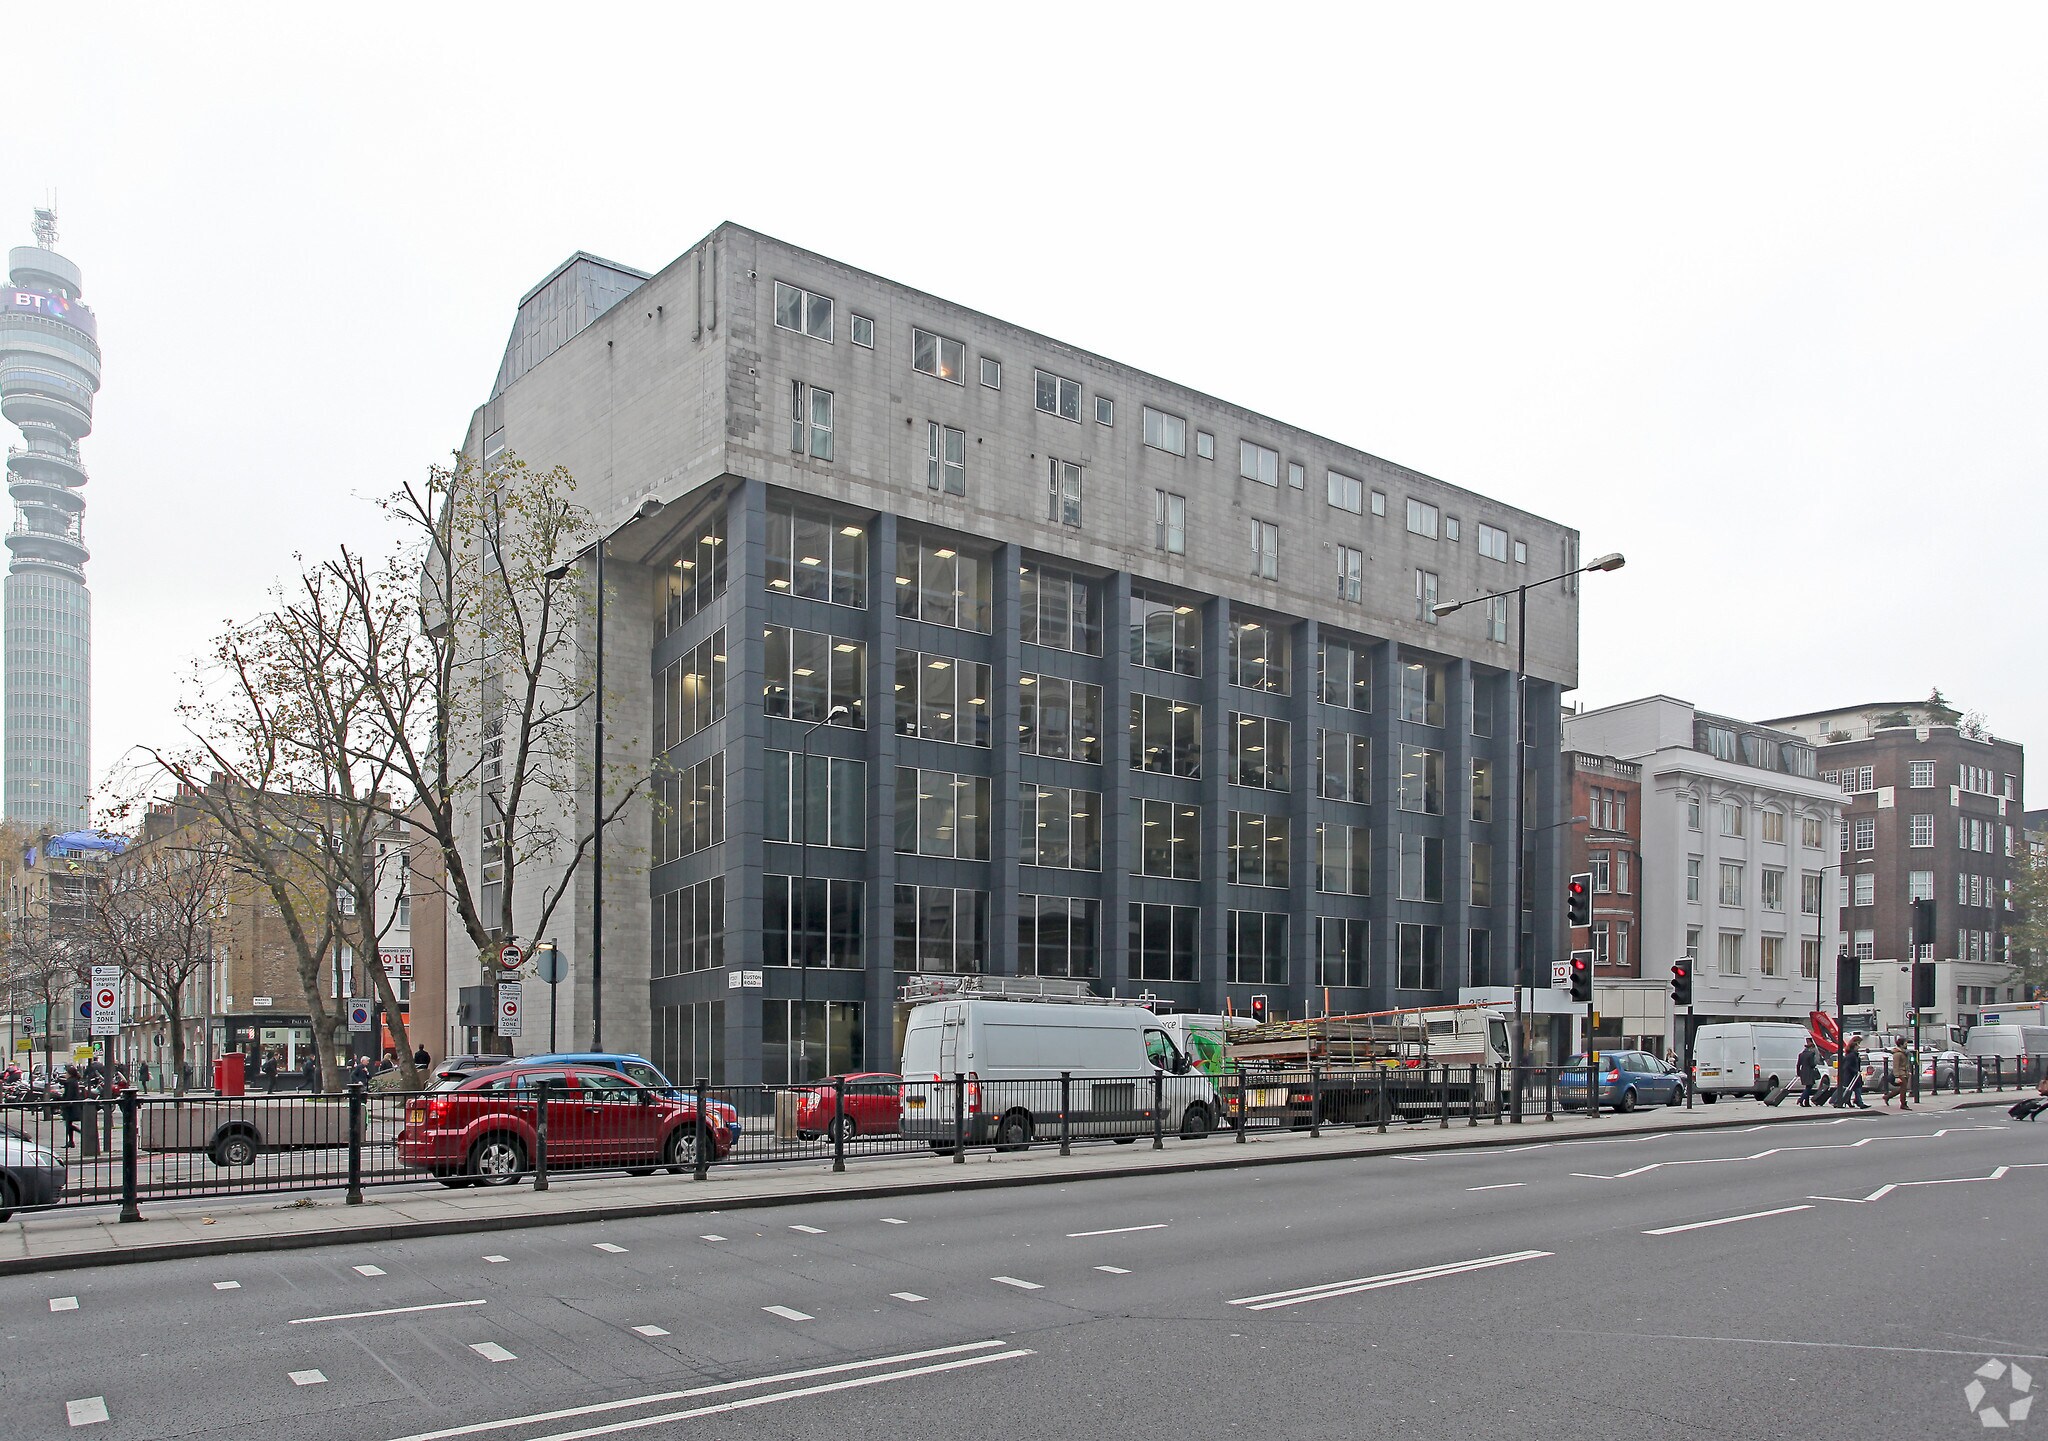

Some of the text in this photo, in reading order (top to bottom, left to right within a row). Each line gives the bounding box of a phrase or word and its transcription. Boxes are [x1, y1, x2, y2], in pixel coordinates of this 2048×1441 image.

[15, 292, 46, 313] BT
[394, 954, 410, 964] LET
[1554, 967, 1565, 976] TO
